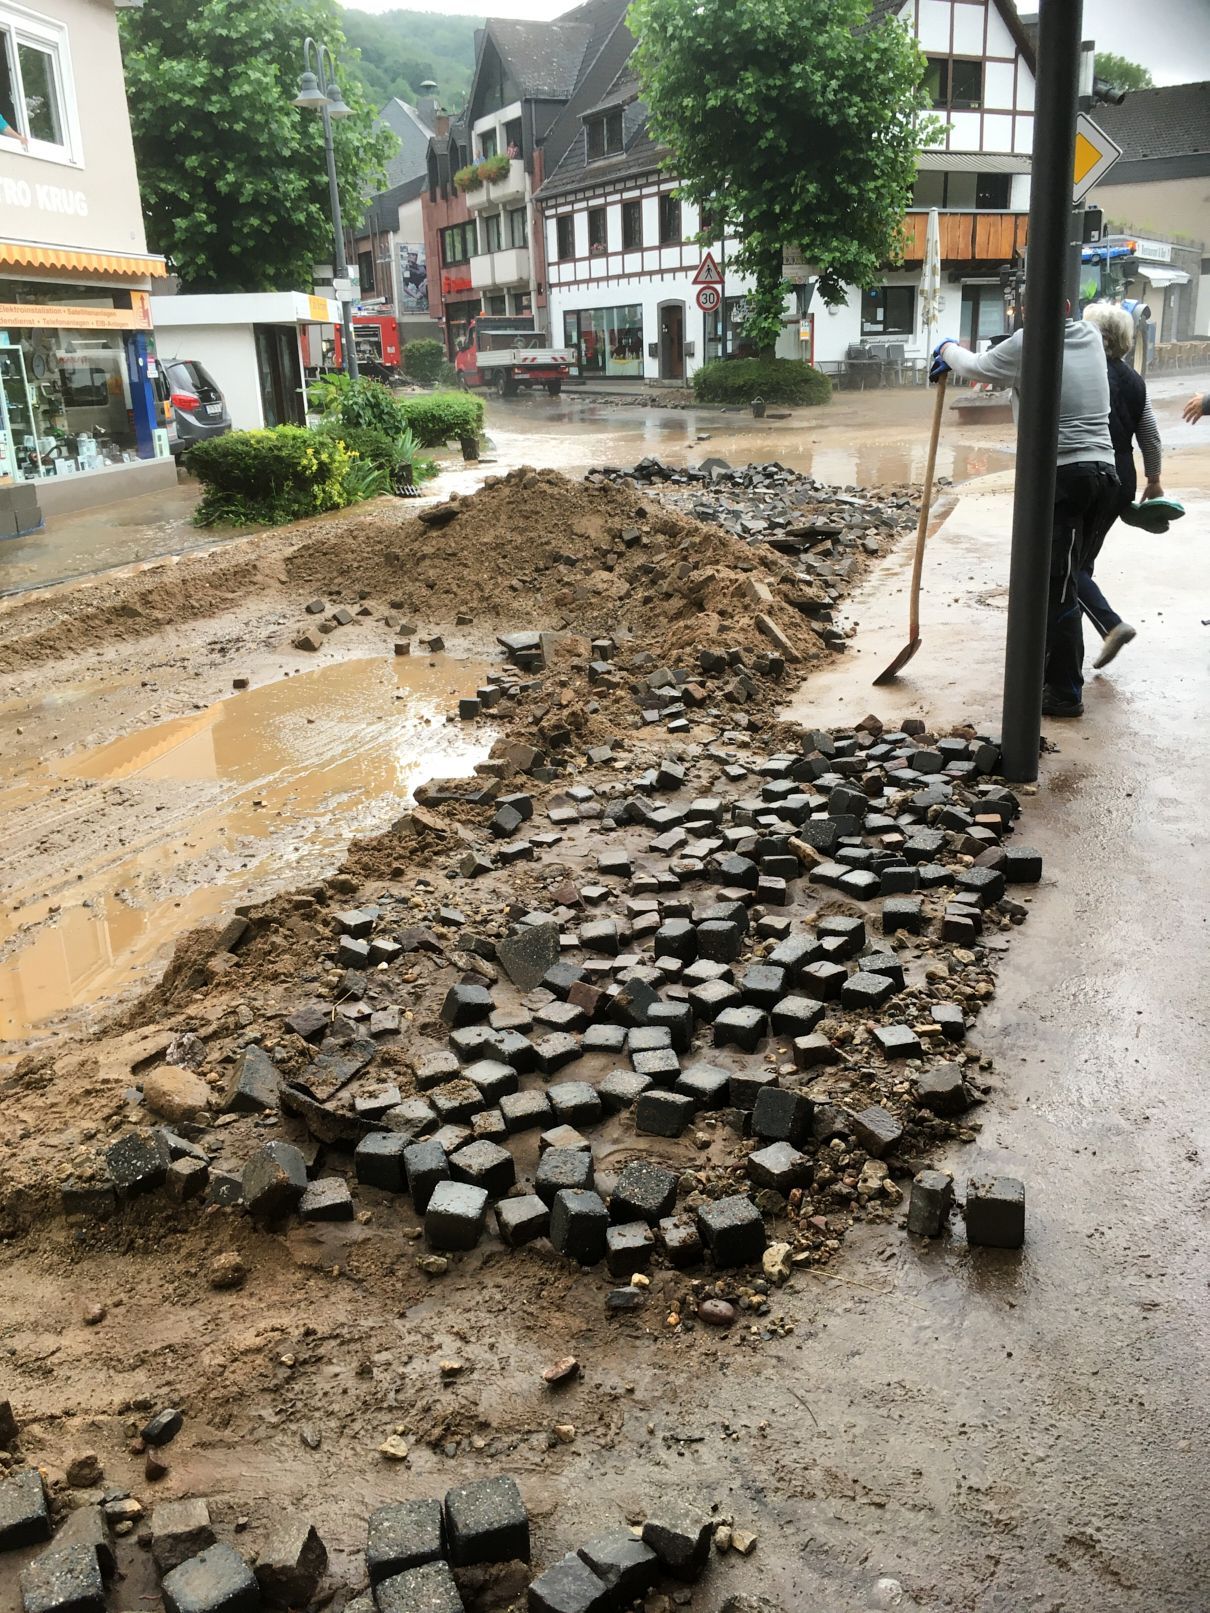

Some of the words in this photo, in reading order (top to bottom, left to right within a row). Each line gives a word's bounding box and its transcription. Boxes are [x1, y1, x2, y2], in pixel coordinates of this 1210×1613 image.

[0, 176, 31, 208] RO
[35, 184, 88, 217] KRUG
[702, 293, 714, 304] 30
